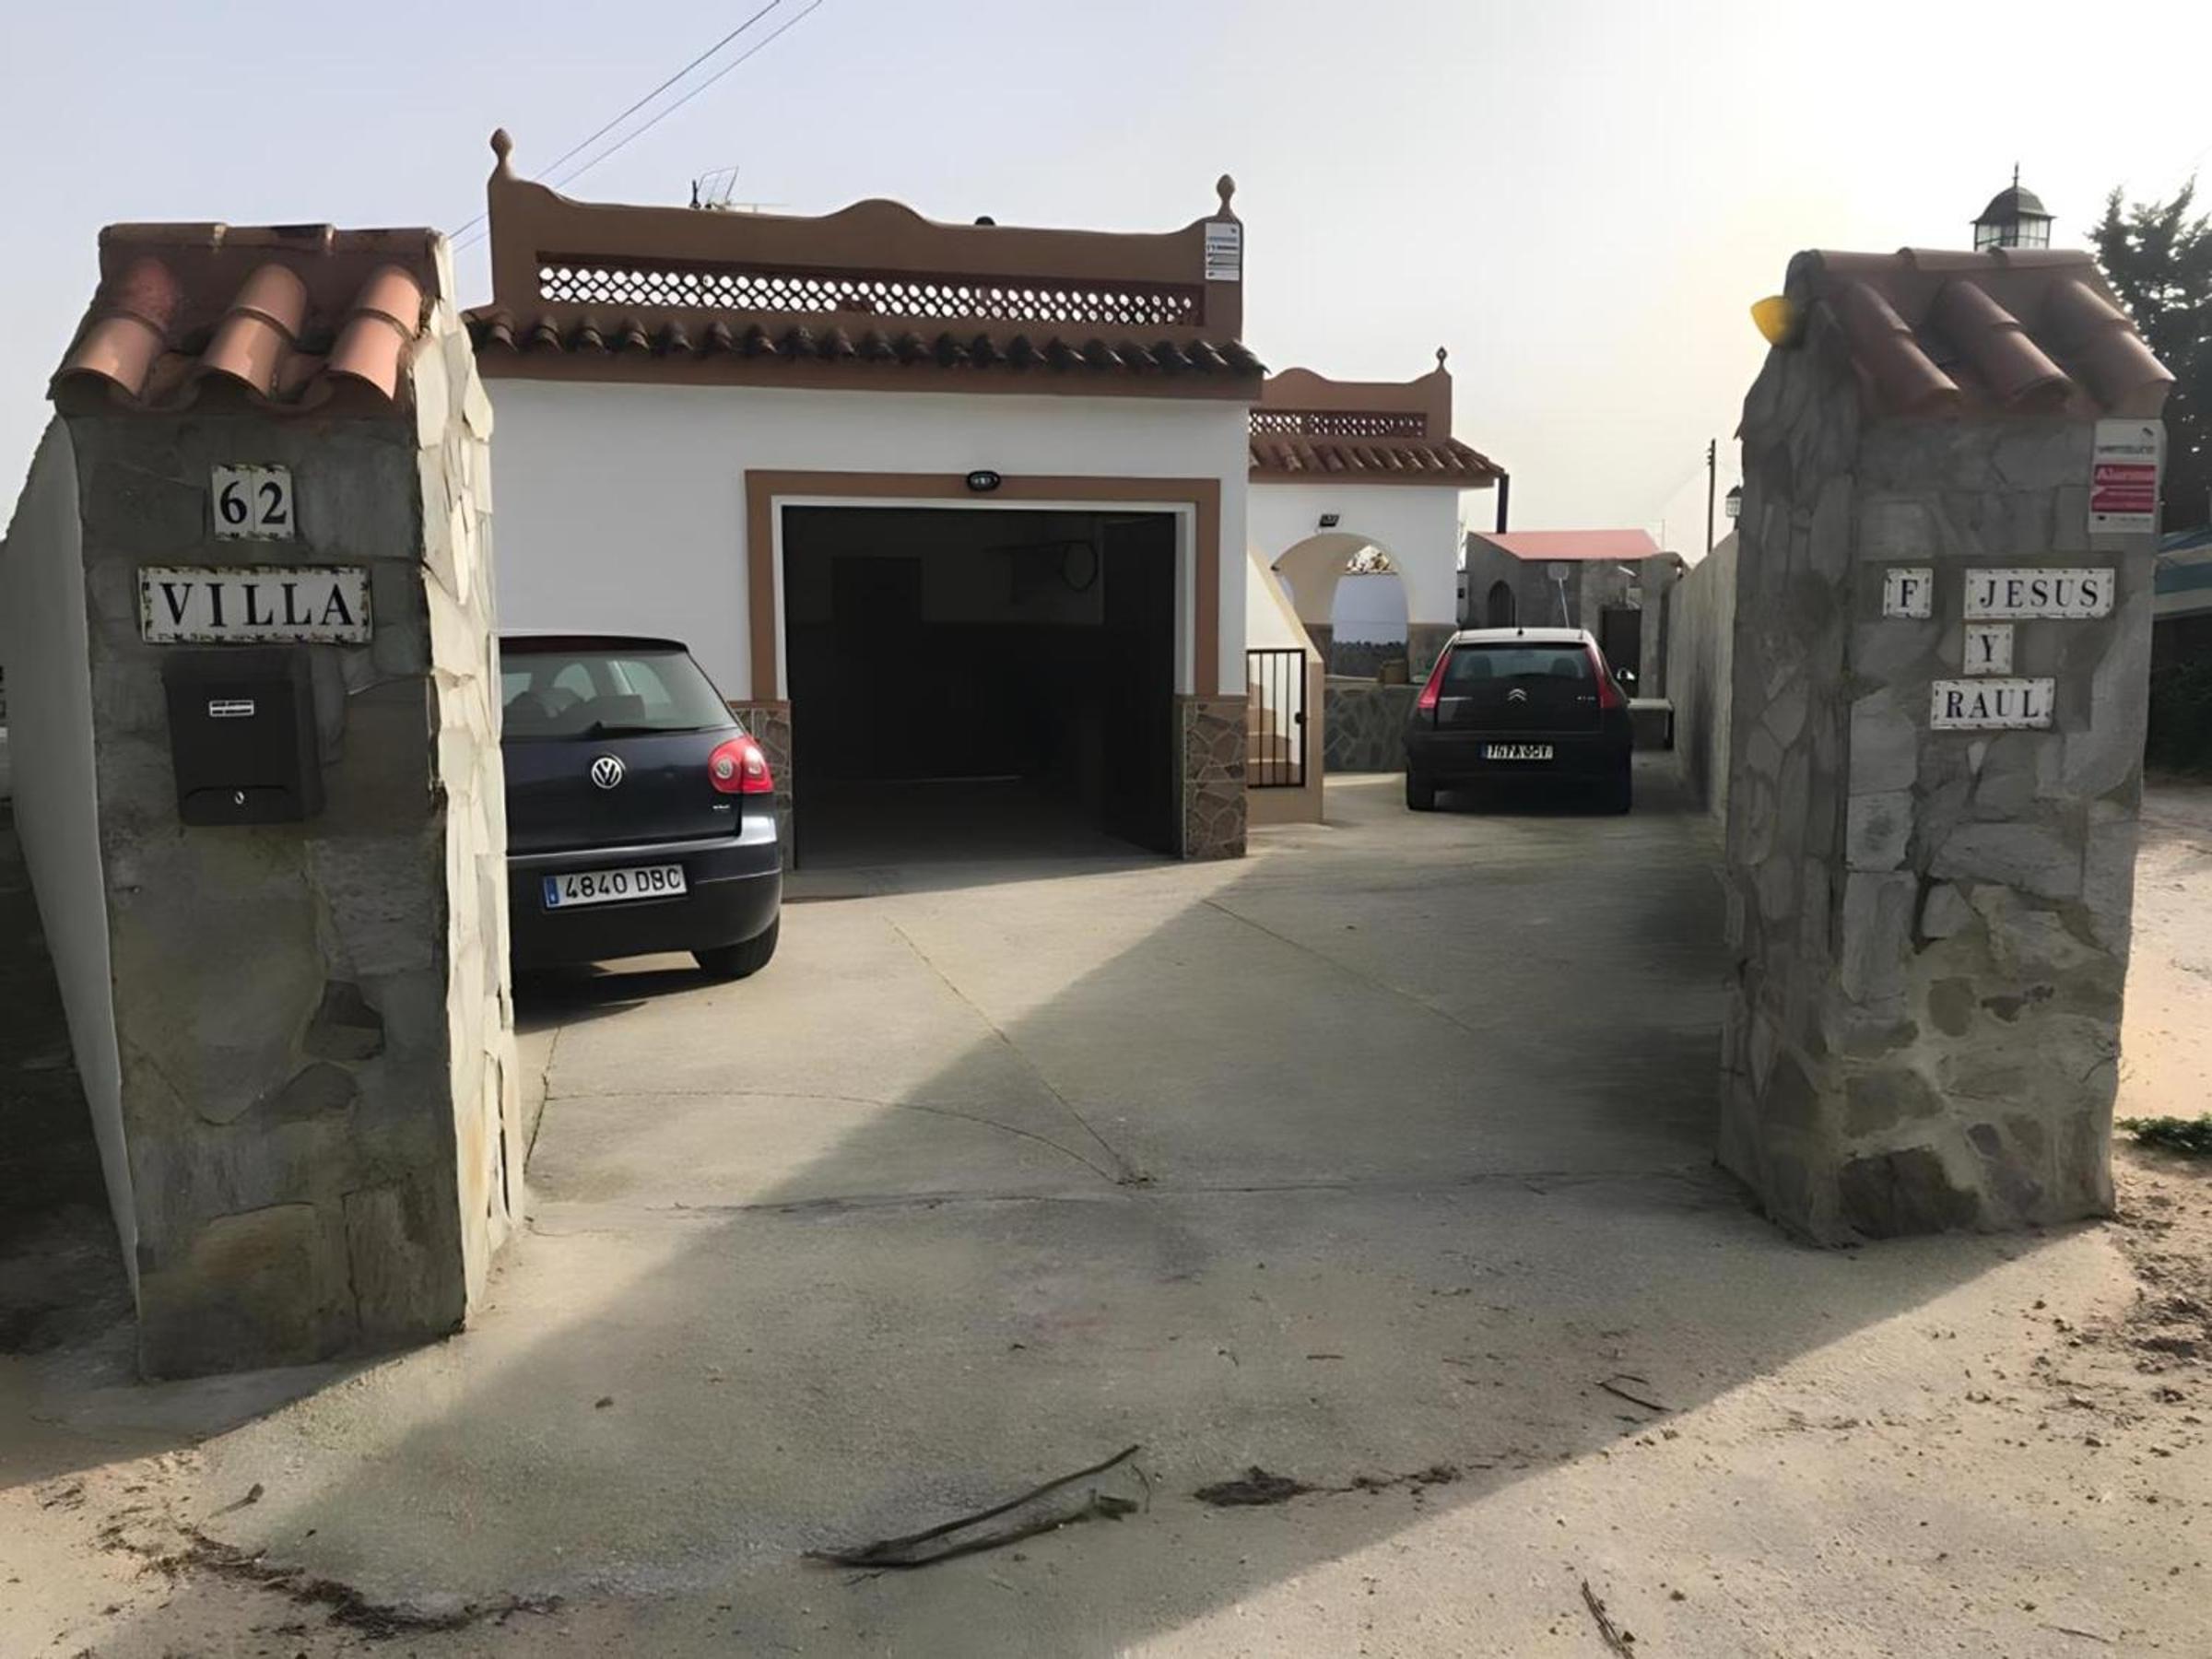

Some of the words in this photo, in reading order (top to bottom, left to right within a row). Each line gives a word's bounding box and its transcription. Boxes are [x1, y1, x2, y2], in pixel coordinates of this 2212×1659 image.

[220, 480, 288, 524] 62
[159, 582, 355, 628] VILLA
[1899, 578, 1919, 608] F
[1978, 578, 2100, 608] JESUS
[1980, 633, 2000, 663] Y
[1945, 688, 2040, 719] RAUL
[565, 872, 629, 900] 4840
[634, 866, 682, 893] DBC
